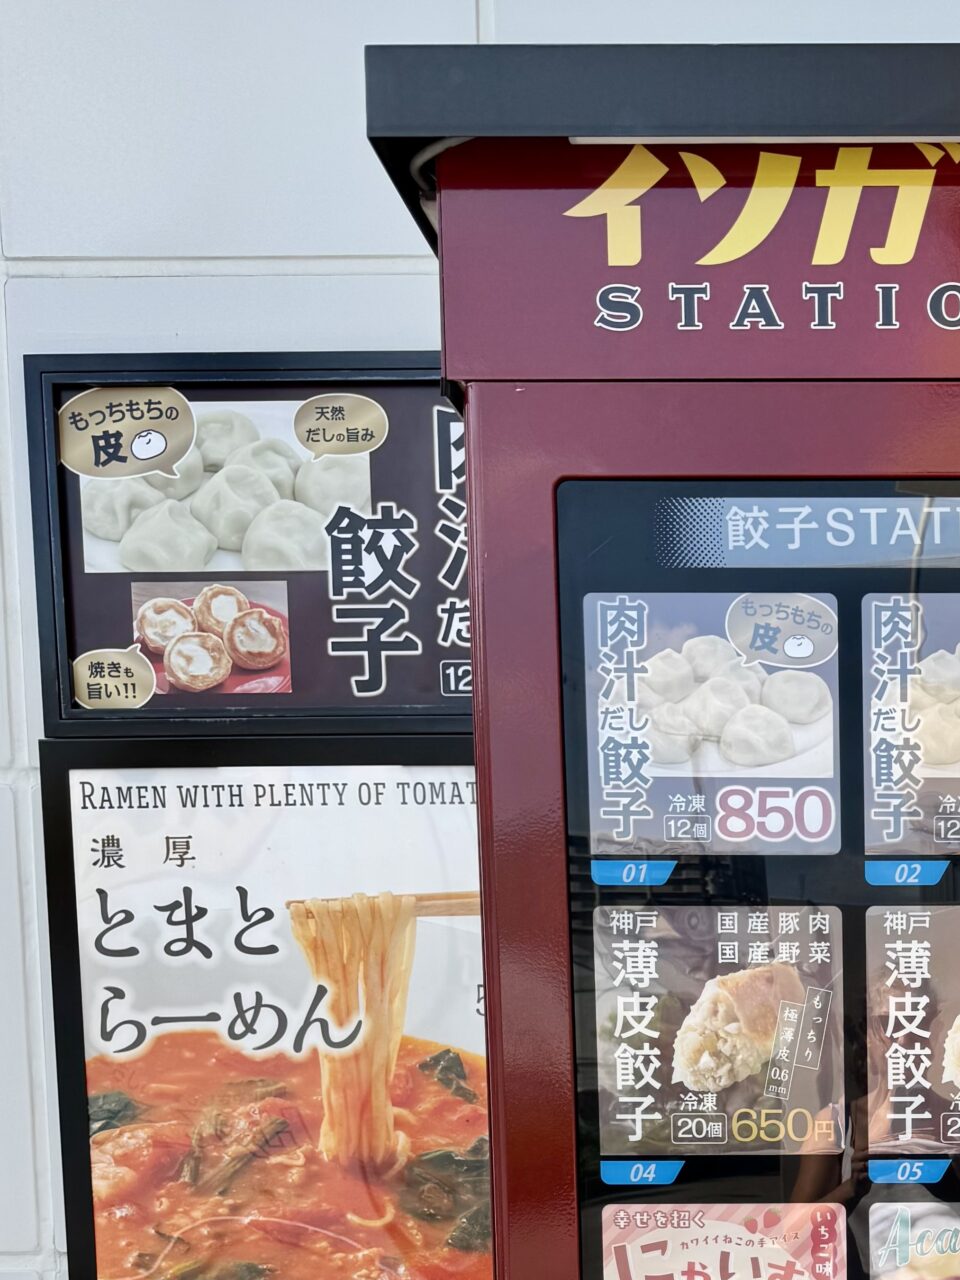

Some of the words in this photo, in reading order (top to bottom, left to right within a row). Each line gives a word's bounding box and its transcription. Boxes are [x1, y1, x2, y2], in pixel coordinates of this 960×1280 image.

[69, 399, 179, 430] もっちもちの
[315, 406, 345, 421] 天然
[305, 427, 376, 443] だしの旨み
[91, 430, 127, 466] 皮
[325, 504, 421, 697] 餃子
[88, 662, 134, 678] 焼きも
[86, 682, 137, 700] 旨い!!
[80, 781, 167, 810] RAMEN
[177, 784, 245, 809] WITH
[254, 783, 349, 807] PLENTY
[358, 782, 386, 806] OF
[717, 787, 833, 840] 850
[667, 819, 707, 838] 12個
[622, 864, 647, 882] 01
[894, 864, 921, 882] 02
[93, 885, 280, 959] とまと
[609, 911, 659, 935] 神戸
[717, 912, 830, 934] 国産豚肉
[717, 941, 831, 964] 国産野菜
[100, 984, 363, 1054] らーめん
[804, 996, 822, 1062] もっちり
[611, 940, 662, 1142] 薄皮餃子
[885, 940, 932, 1141] 薄皮餃子
[677, 1118, 722, 1138] 20個
[629, 1164, 656, 1182] 04
[897, 1162, 922, 1181] 05
[614, 1210, 706, 1229] 幸せを招く
